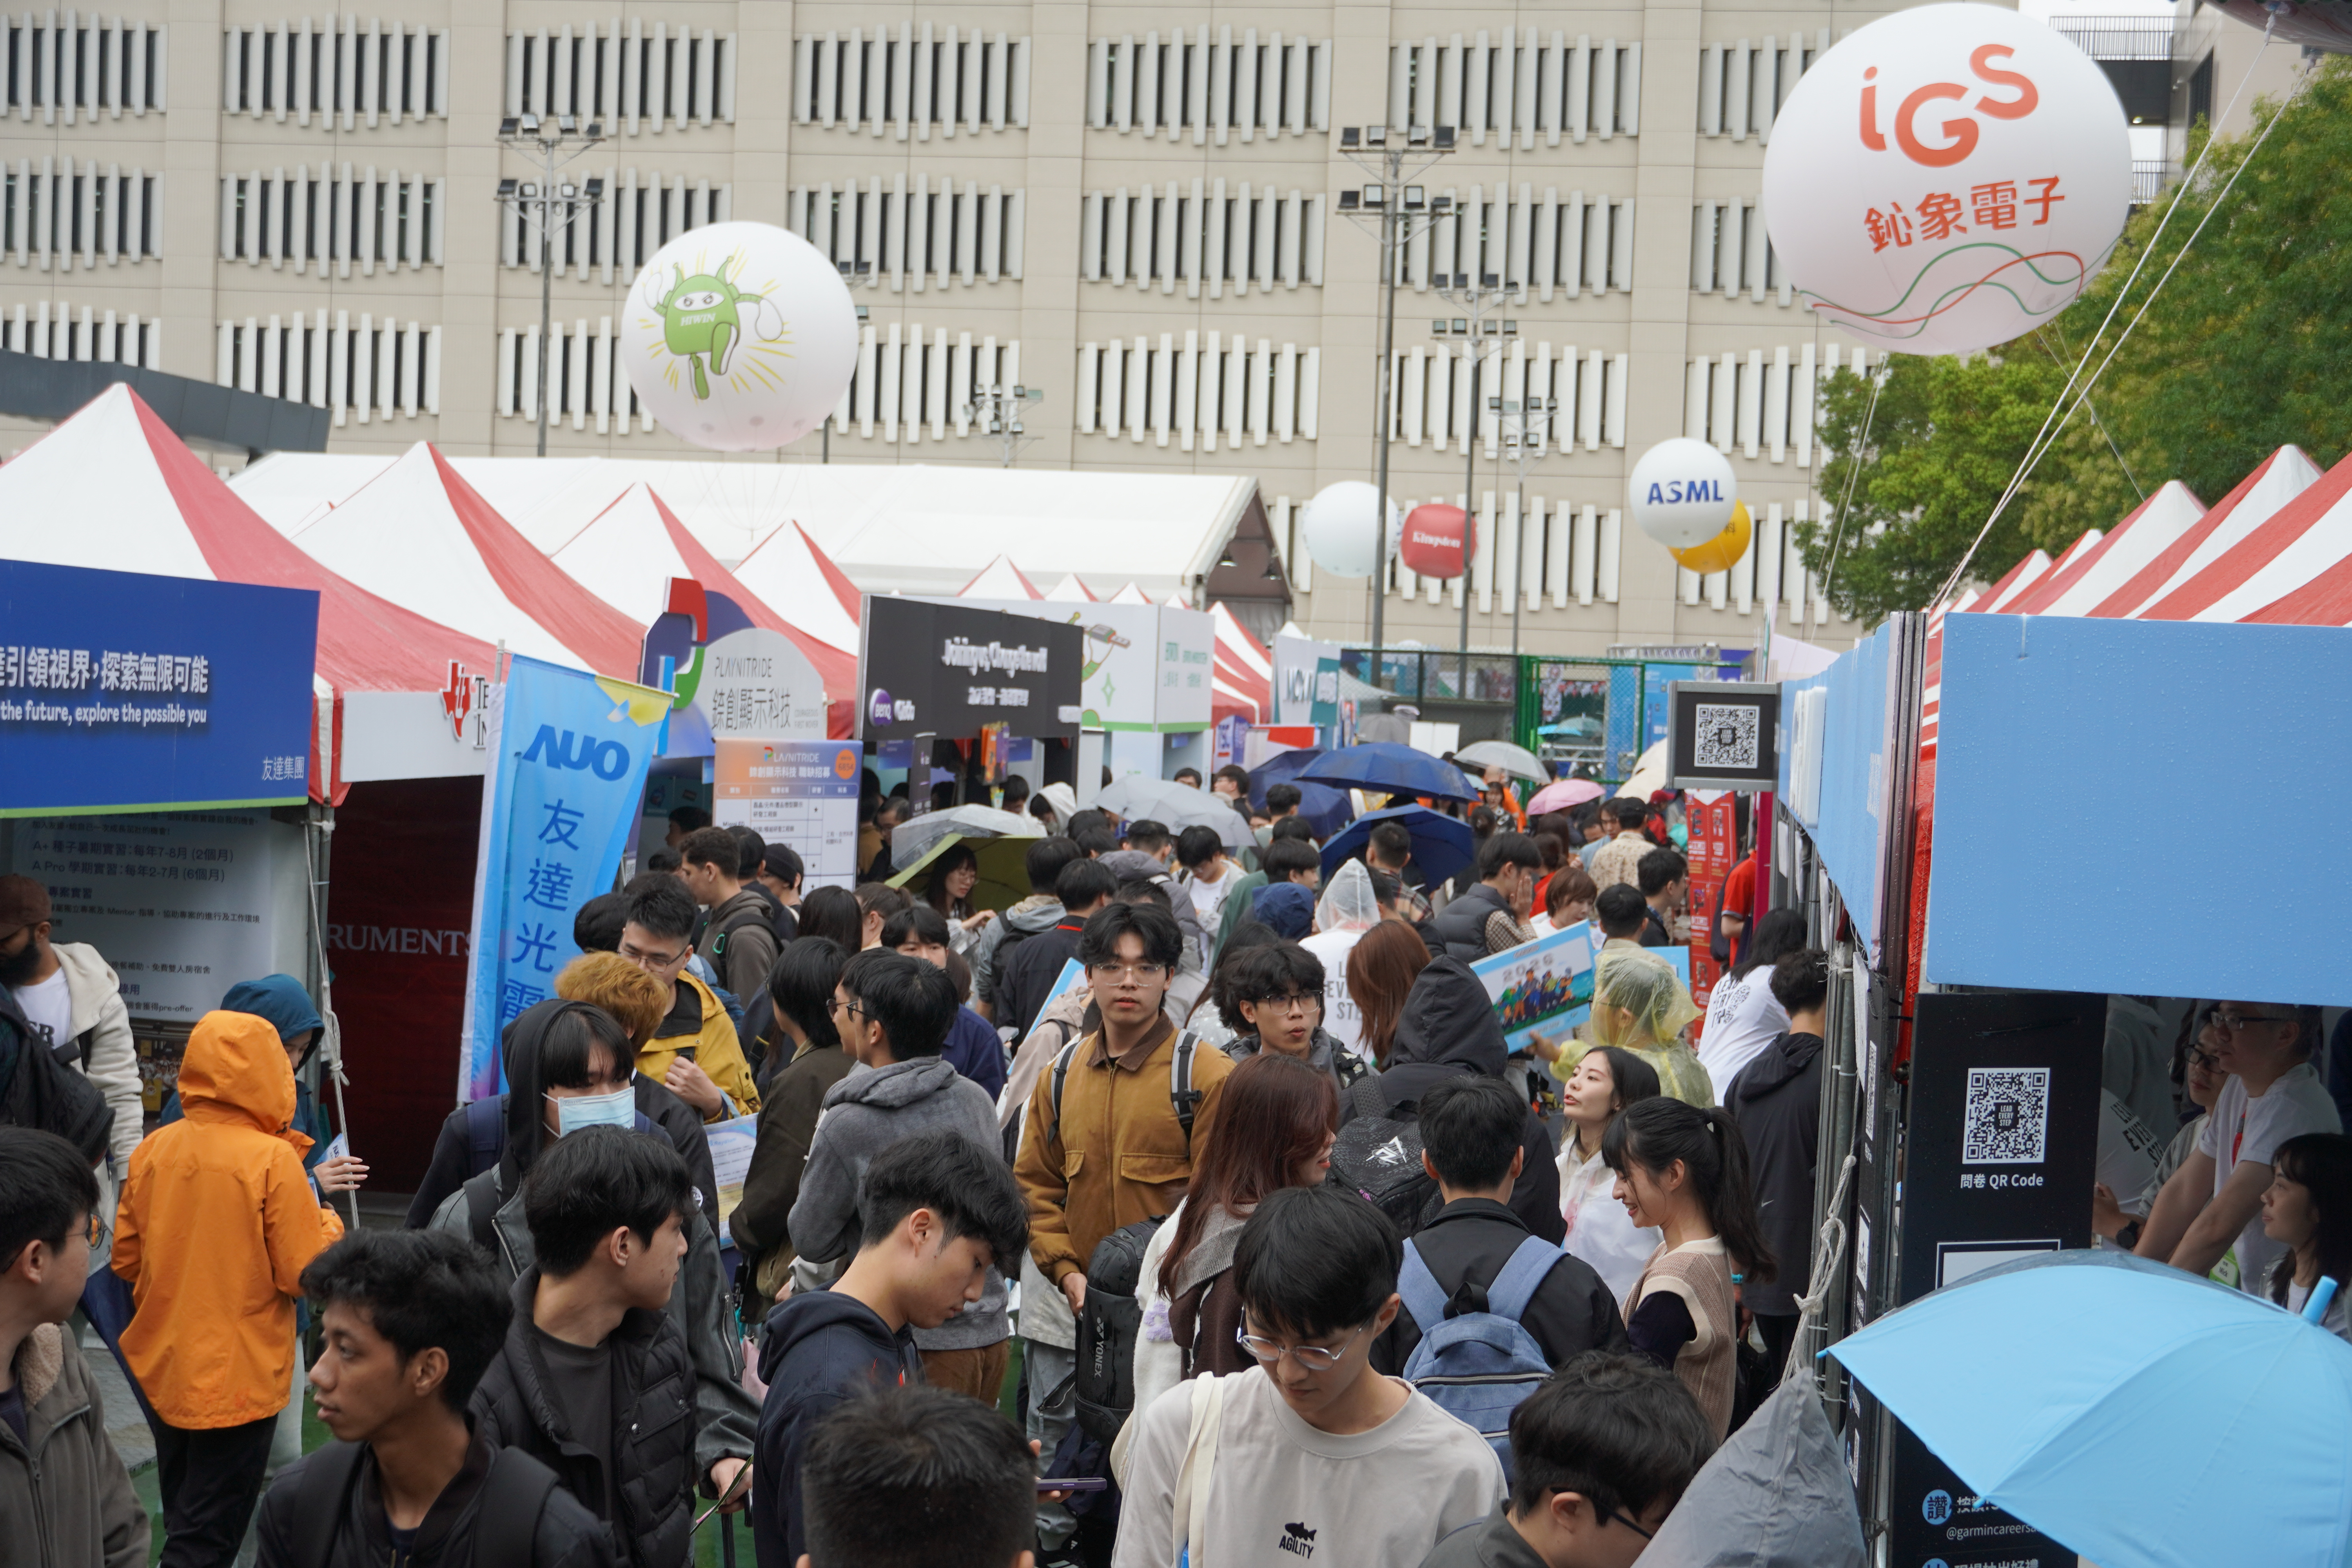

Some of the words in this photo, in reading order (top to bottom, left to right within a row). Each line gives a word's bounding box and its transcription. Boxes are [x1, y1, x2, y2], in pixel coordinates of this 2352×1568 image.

[680, 312, 716, 327] HIWIN
[1647, 480, 1724, 505] ASML
[0, 646, 209, 693] 引領視界，探索無限可能
[715, 657, 772, 677] PLAYNITRIDE
[1, 699, 23, 720] the
[25, 699, 73, 727] future,
[76, 702, 120, 727] explore
[122, 702, 142, 722] the
[143, 704, 186, 727] possible
[187, 709, 207, 728] you
[522, 724, 630, 781] AUO
[262, 755, 305, 780] 友達集團
[33, 840, 49, 852] A+
[32, 860, 41, 871] A
[44, 861, 65, 873] Pro
[107, 907, 136, 916] Mentor
[1960, 1173, 1986, 1189] 問卷
[1989, 1174, 2008, 1190] QR
[2011, 1173, 2044, 1187] Code
[2218, 1267, 2228, 1278] Mick
[1094, 1340, 1104, 1378] YONEX
[1279, 1535, 1314, 1559] AGILITY
